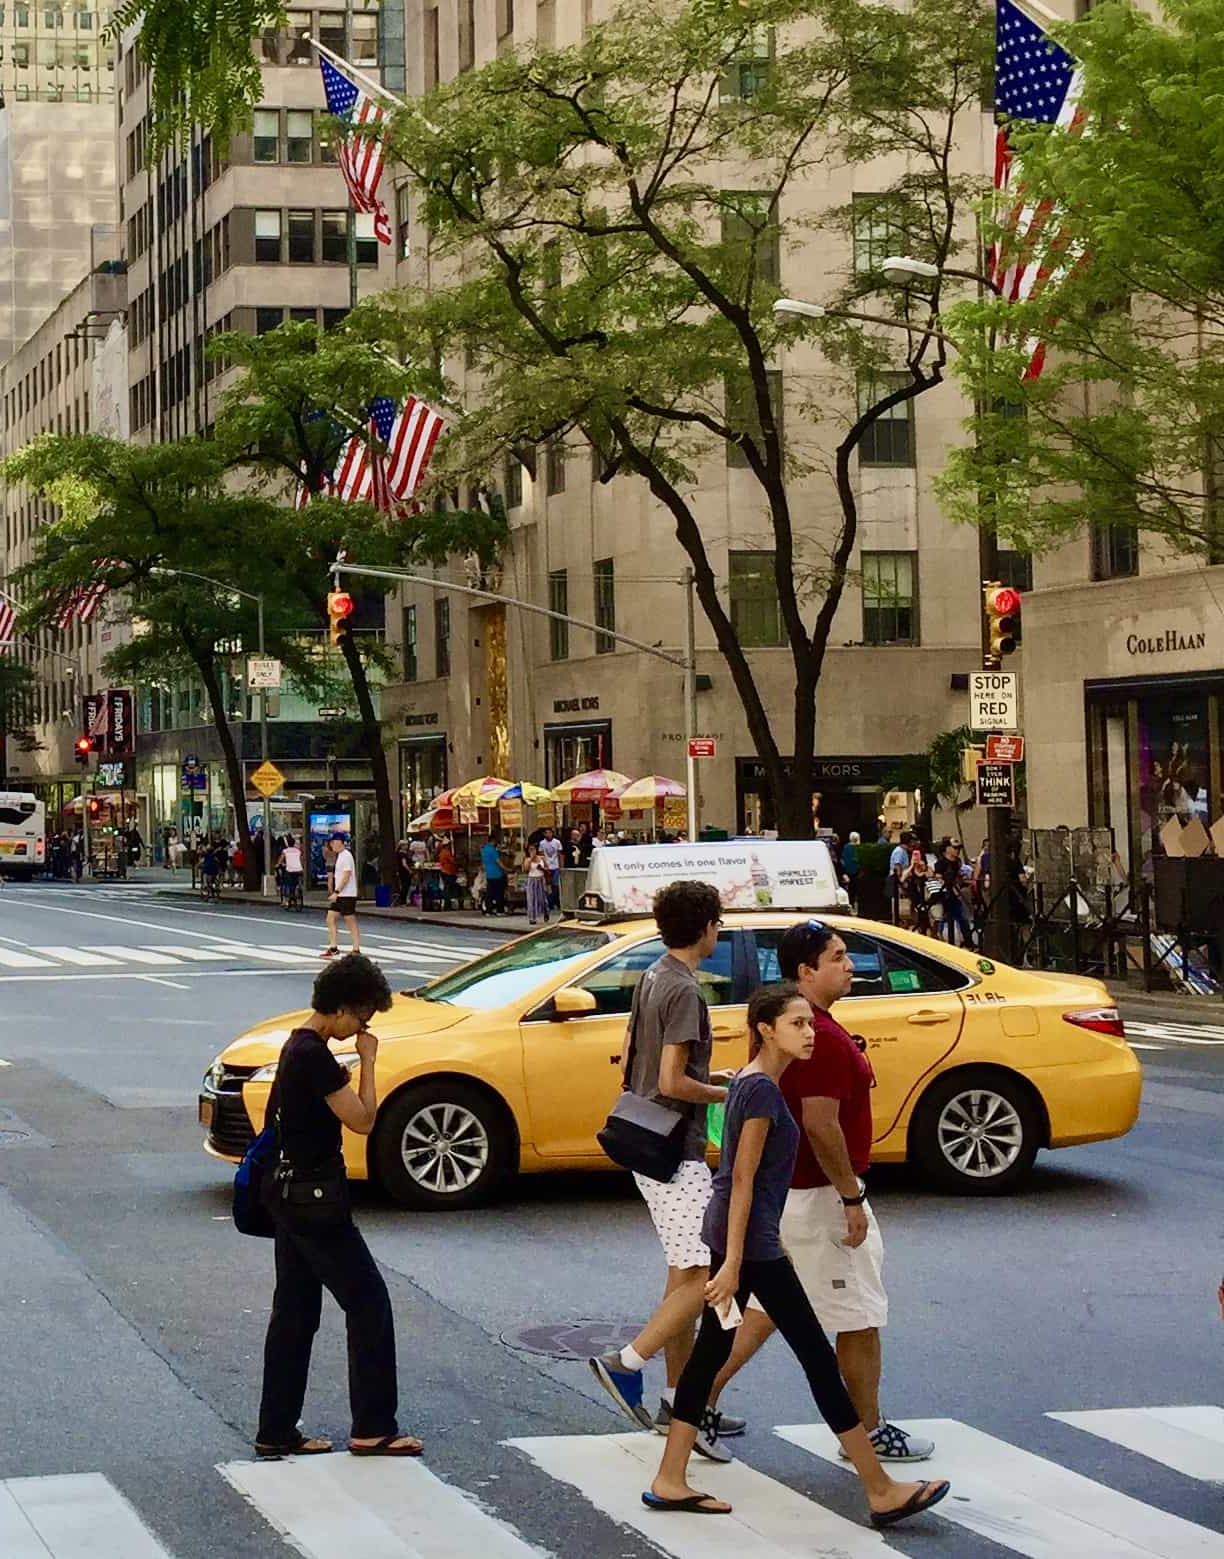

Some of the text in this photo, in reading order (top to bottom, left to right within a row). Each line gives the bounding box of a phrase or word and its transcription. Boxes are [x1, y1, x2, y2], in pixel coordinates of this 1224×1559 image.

[975, 676, 1011, 690] STOP
[979, 702, 1008, 715] RED
[113, 703, 124, 742] FRIDAYS
[822, 764, 862, 777] KORS
[979, 776, 1010, 787] THINK
[624, 861, 645, 871] only
[648, 860, 683, 869] comes
[684, 859, 695, 867] in
[718, 857, 747, 865] flavor
